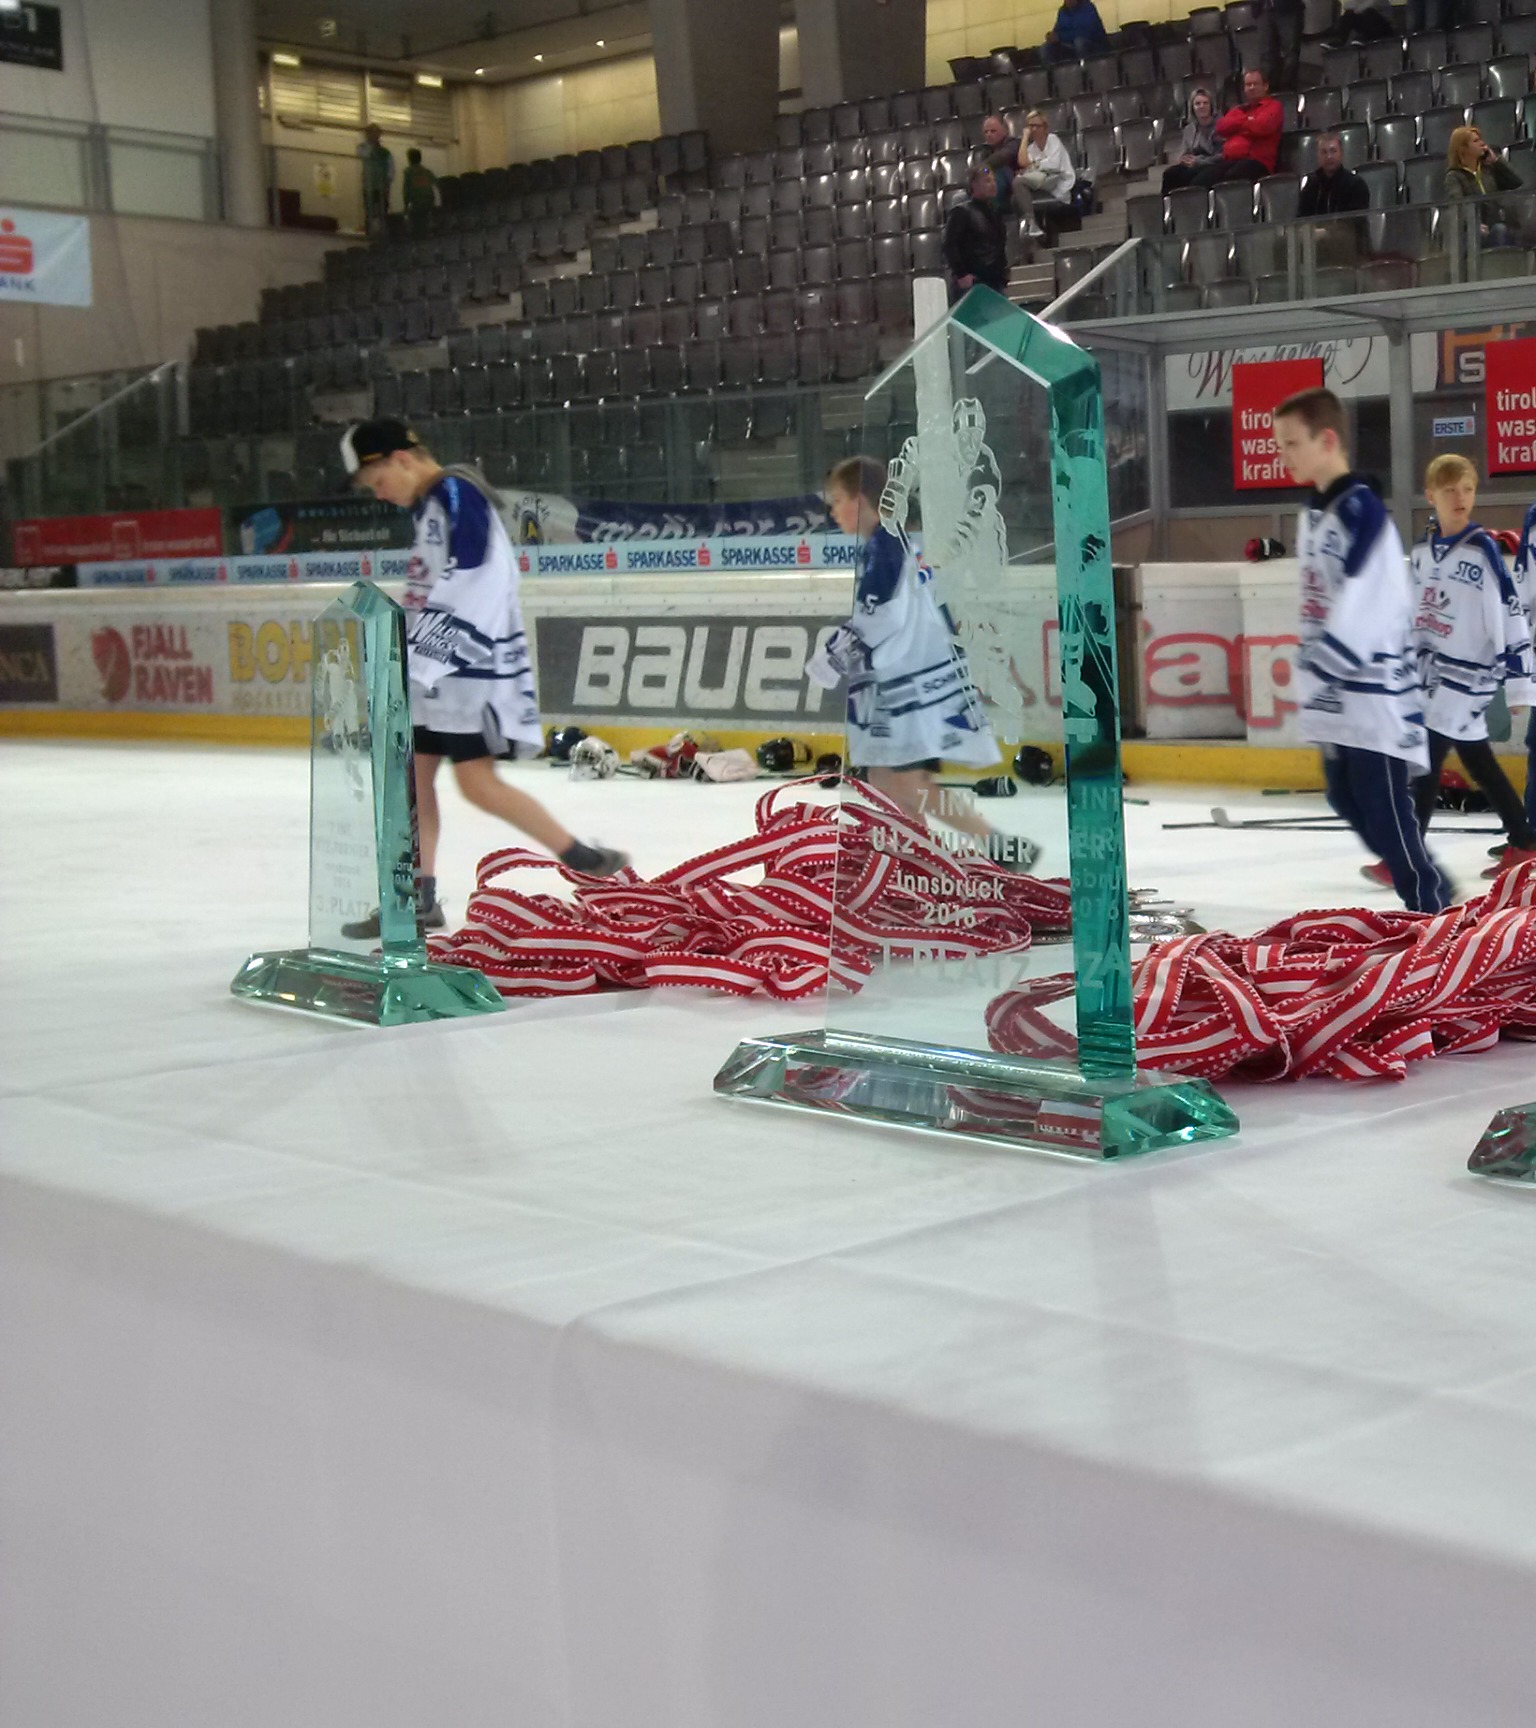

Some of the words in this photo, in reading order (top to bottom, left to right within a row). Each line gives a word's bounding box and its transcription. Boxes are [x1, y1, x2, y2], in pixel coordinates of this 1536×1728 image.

[1241, 406, 1275, 431] tiro
[1433, 421, 1465, 436] ERSTE
[1242, 459, 1286, 482] kraft
[538, 553, 604, 572] SPARKASSE
[626, 549, 697, 568] SPARKASSE
[720, 546, 797, 566] SPARKASSE
[237, 563, 288, 579] SPARKASSE
[304, 561, 361, 578] SPARKASSE
[134, 665, 214, 704] RAVEN
[897, 870, 1006, 901] Innsbruck
[923, 902, 977, 929] 2016
